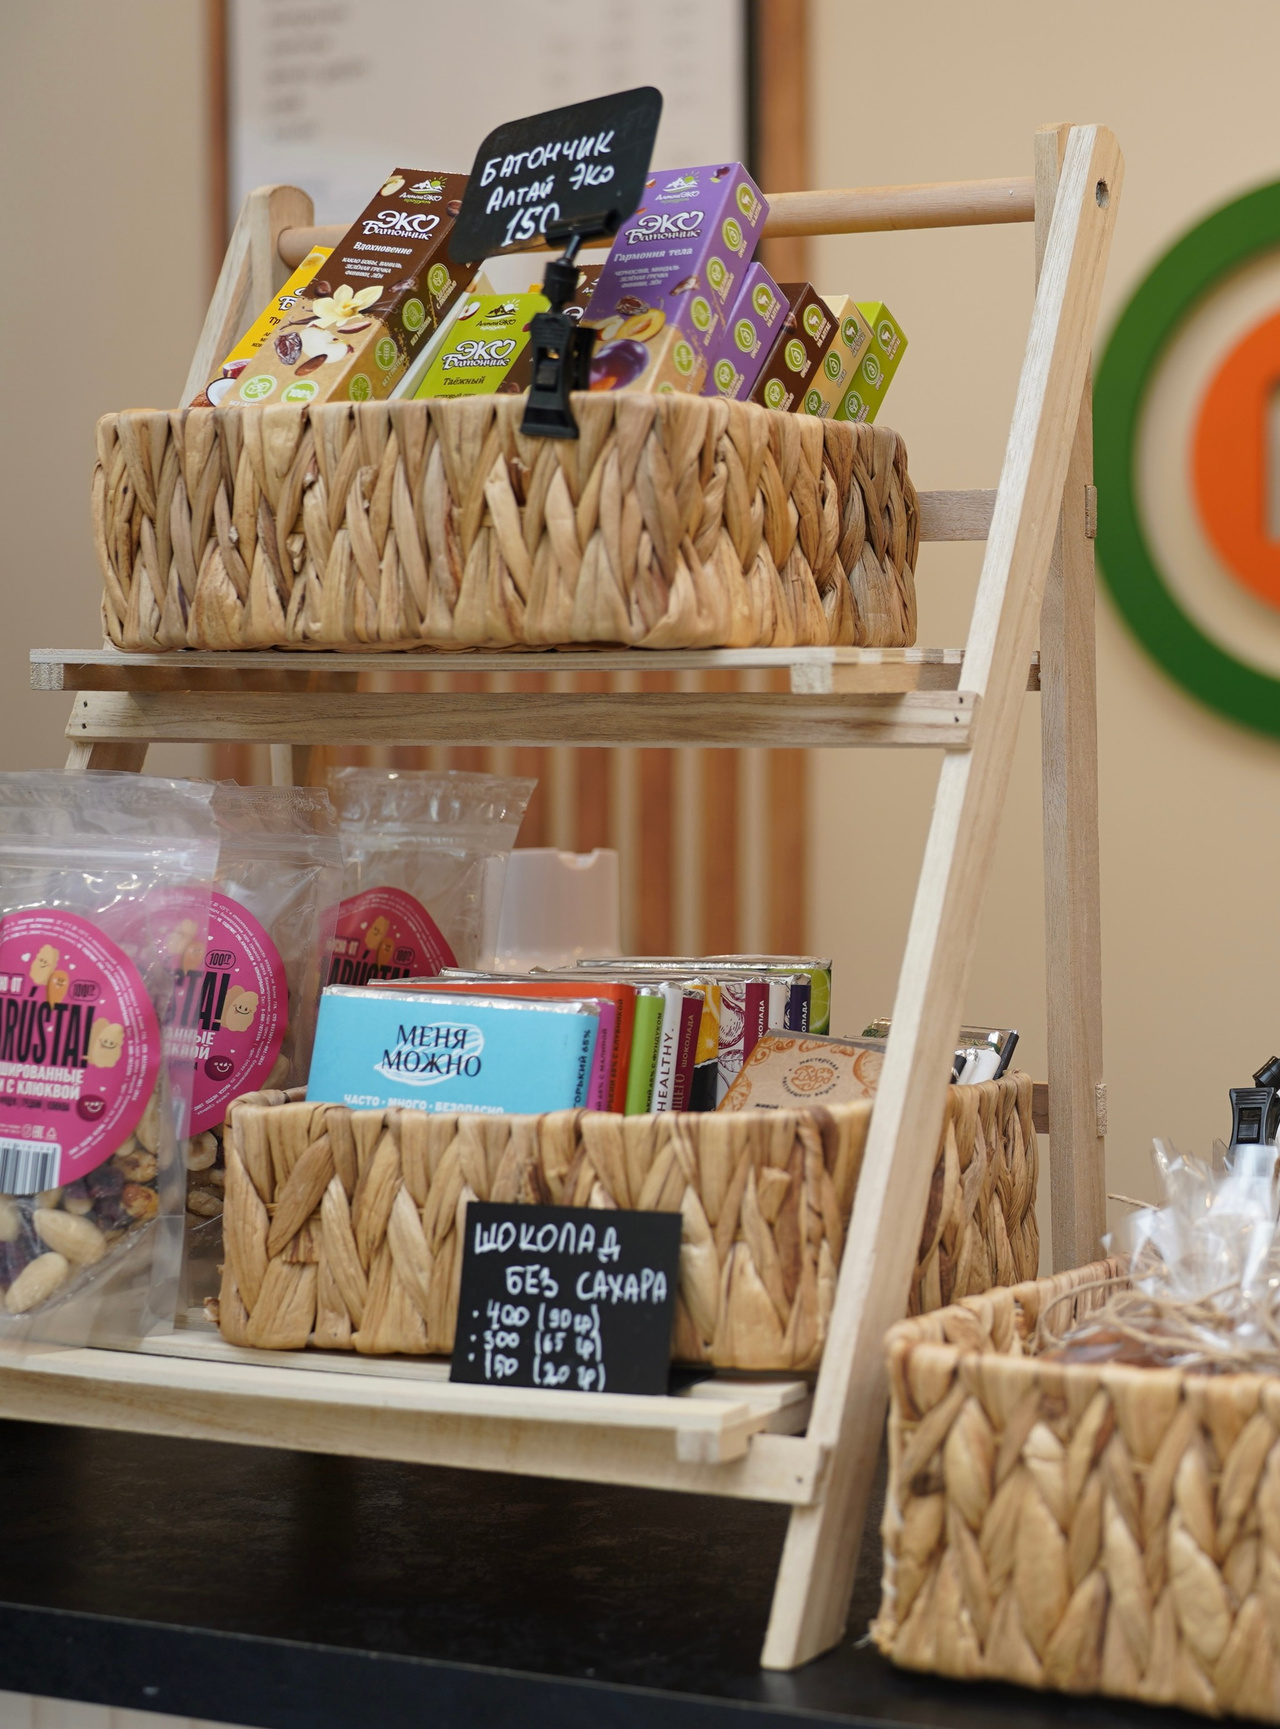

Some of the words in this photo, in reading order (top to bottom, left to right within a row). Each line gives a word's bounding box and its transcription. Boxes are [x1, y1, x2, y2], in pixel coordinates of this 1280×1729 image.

[480, 130, 615, 187] БАТОНЧИК
[362, 220, 433, 240] Батончик
[377, 210, 440, 233] ЭКО
[638, 211, 705, 234] ЭКО
[353, 241, 413, 255] Вдохновение
[625, 229, 701, 246] Батончик
[614, 250, 665, 263] Гармония
[669, 248, 693, 256] тела
[455, 338, 516, 359] ЭКО
[442, 353, 510, 370] Батончик
[443, 376, 485, 386] Таёжный
[396, 1024, 470, 1050] МЕНЯ
[652, 1012, 662, 1062] ФУНДУКОМ
[681, 1014, 694, 1068] ШОКОЛАДА
[381, 1049, 483, 1077] МОЖНО
[16, 1080, 81, 1100] КЛЮКВОЙ
[343, 1094, 380, 1106] ЧАСТО
[388, 1097, 427, 1110] МНОГО
[475, 1222, 621, 1263] ШОКОЛАД
[505, 1264, 559, 1298] БЕЗ
[576, 1267, 668, 1304] САХАРА
